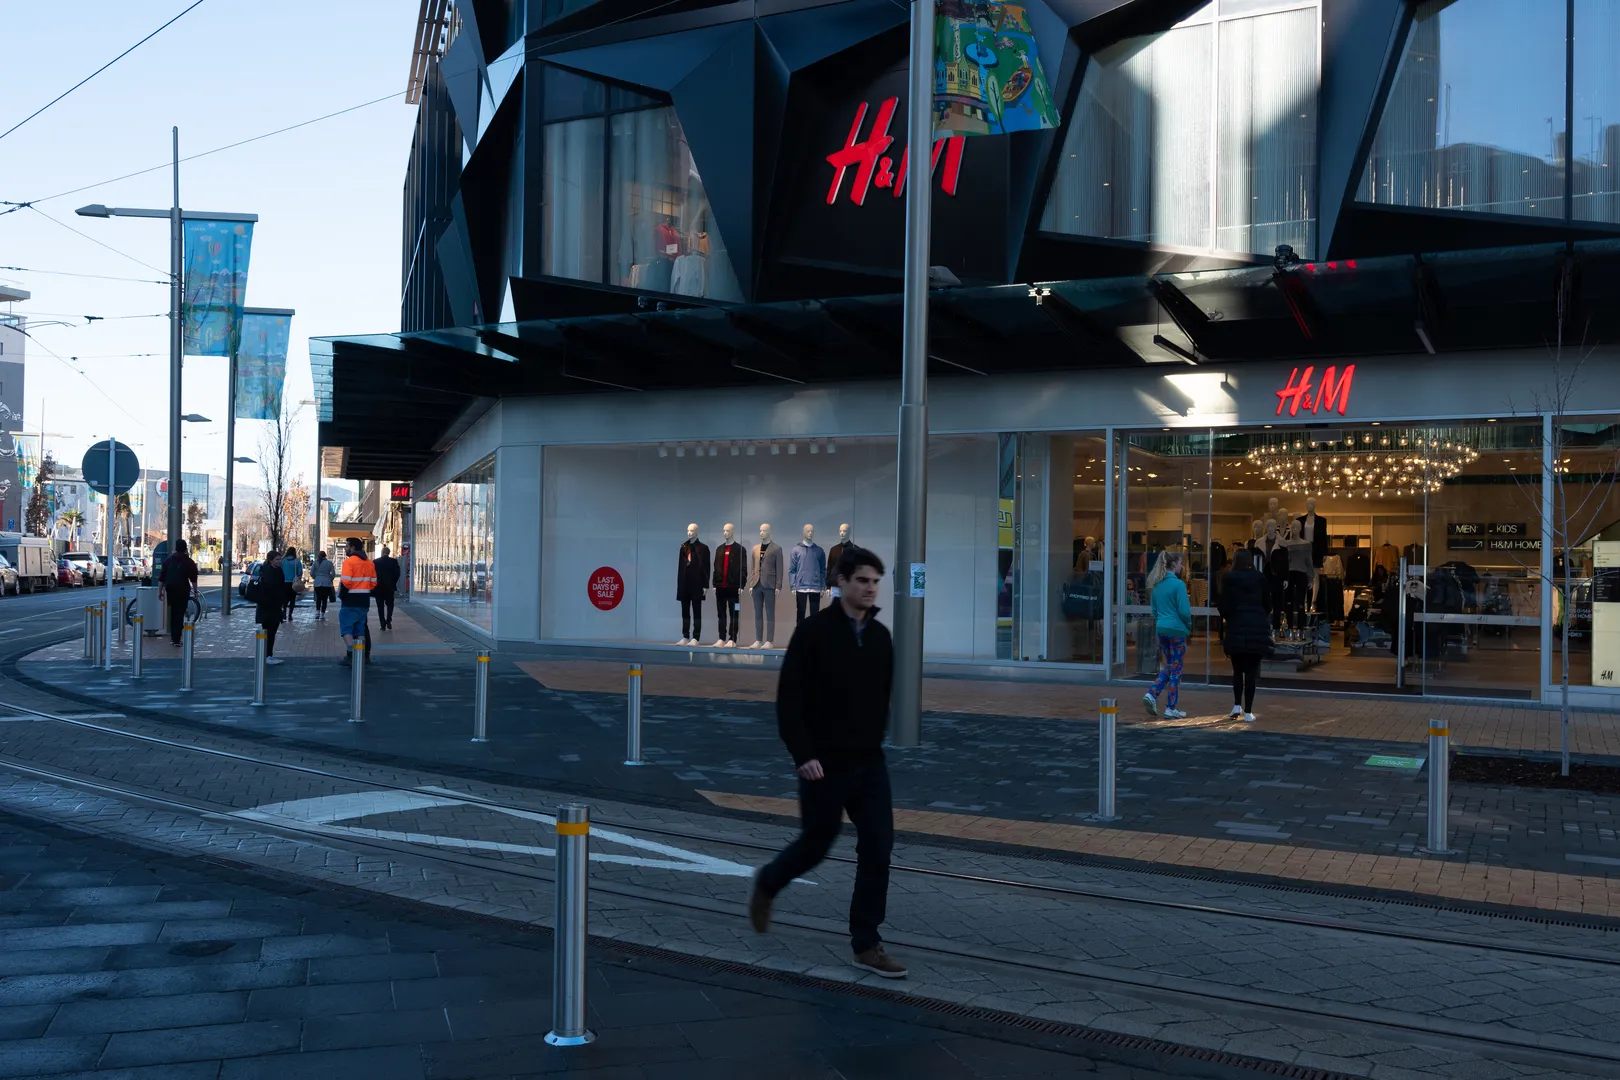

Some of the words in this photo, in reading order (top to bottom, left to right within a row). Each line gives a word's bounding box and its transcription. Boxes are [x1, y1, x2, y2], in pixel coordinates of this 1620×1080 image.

[1275, 364, 1355, 417] H&M
[1455, 524, 1477, 533] MEN
[1496, 524, 1518, 533] KIDS
[1490, 540, 1513, 549] H&M
[597, 576, 615, 584] LAST
[592, 583, 610, 591] DAYS
[610, 583, 620, 591] OF
[597, 590, 615, 598] SALE
